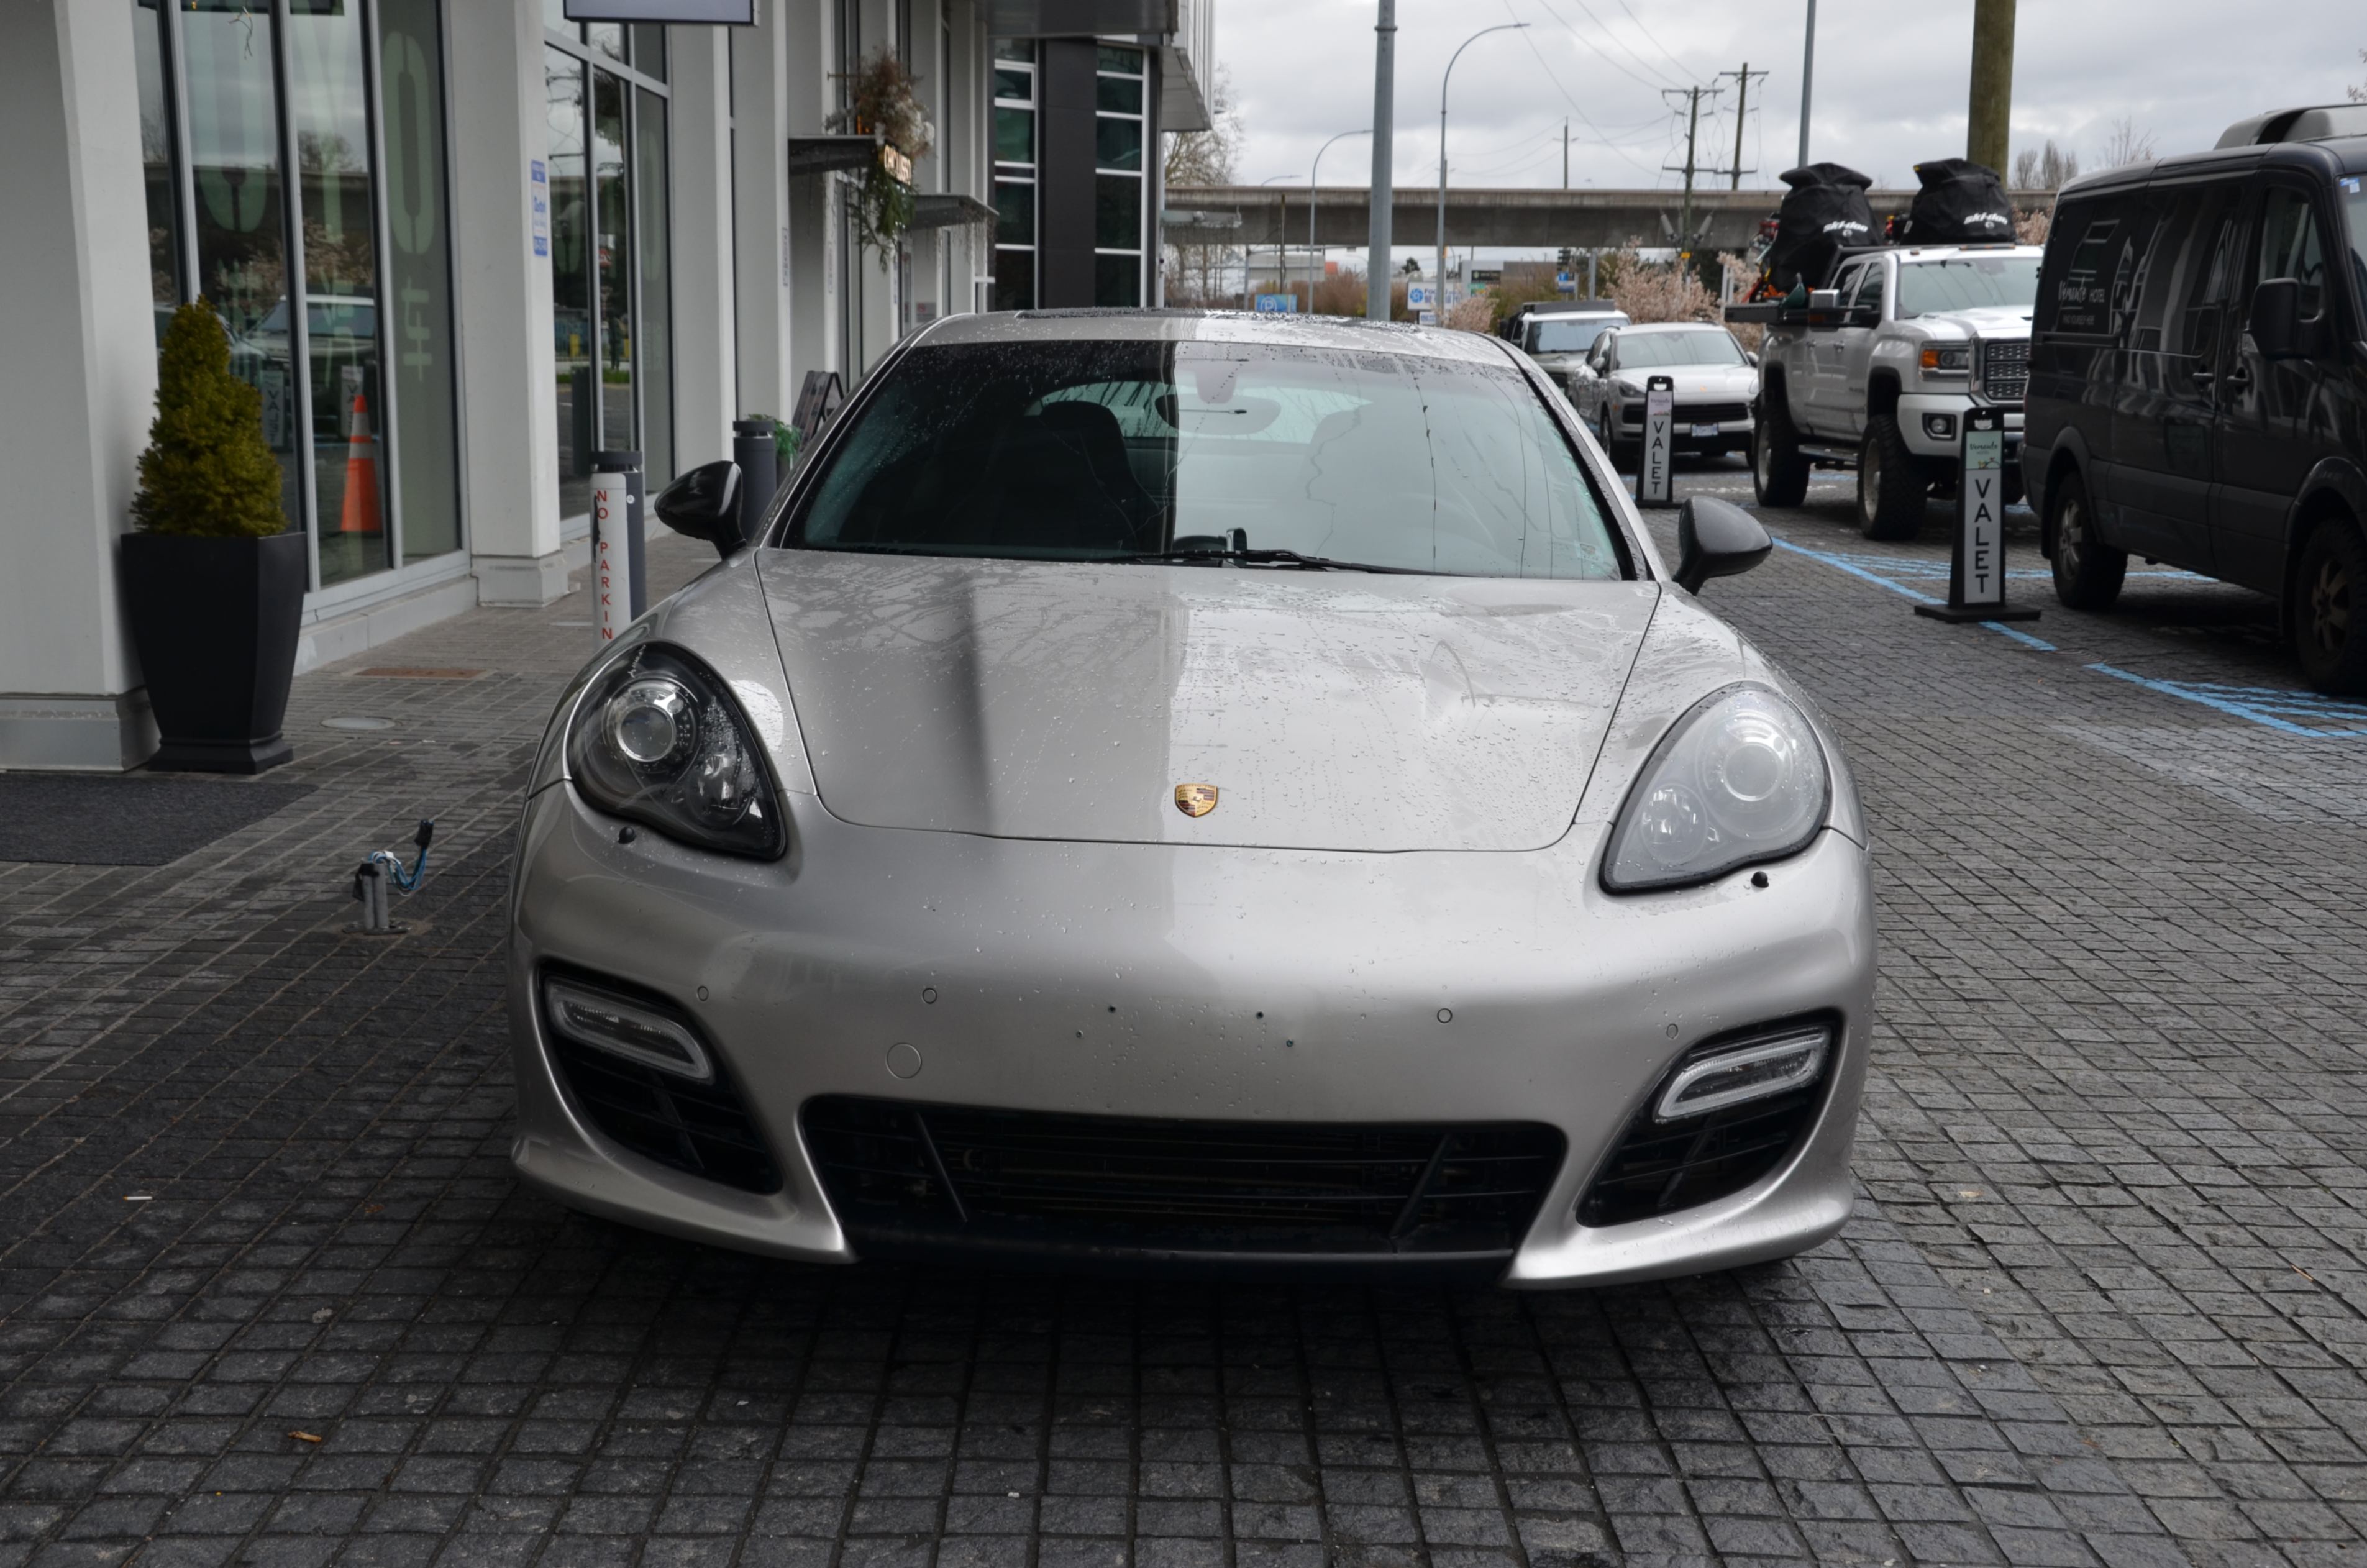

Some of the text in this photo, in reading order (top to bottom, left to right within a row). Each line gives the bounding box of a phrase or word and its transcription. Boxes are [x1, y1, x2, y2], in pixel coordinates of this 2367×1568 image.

[2089, 288, 2105, 303] HOTEL
[1651, 421, 1664, 495] VALET
[596, 490, 608, 520] NO
[1974, 478, 1992, 593] VALET
